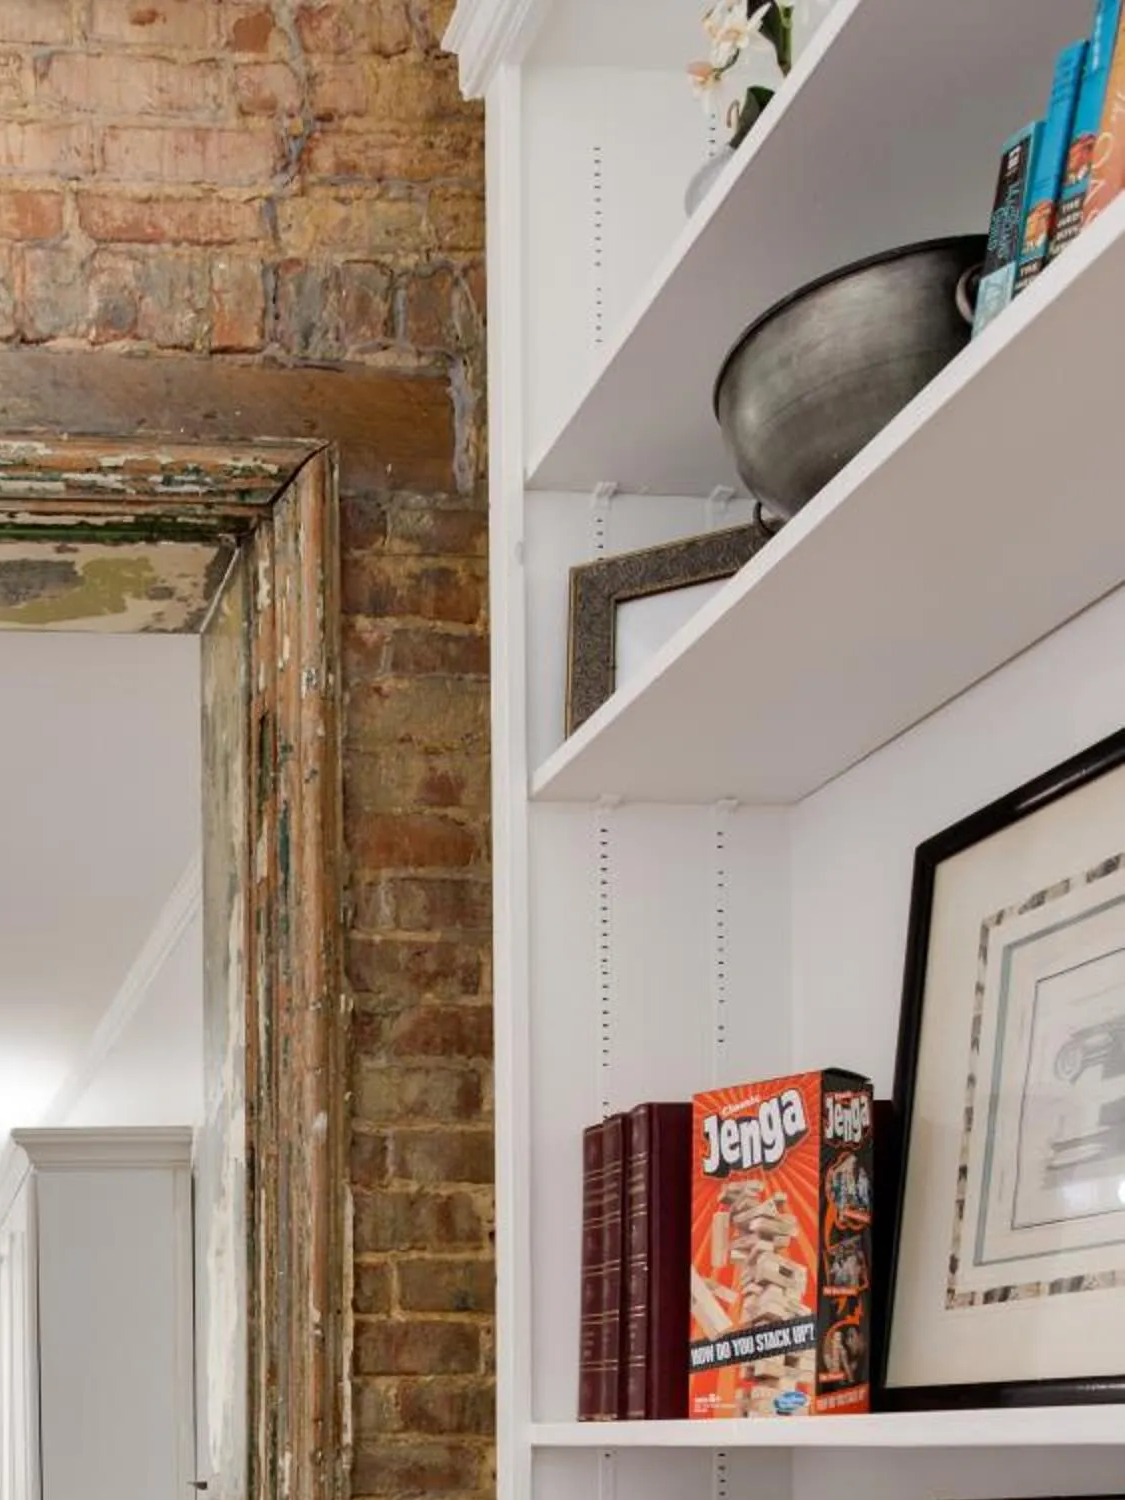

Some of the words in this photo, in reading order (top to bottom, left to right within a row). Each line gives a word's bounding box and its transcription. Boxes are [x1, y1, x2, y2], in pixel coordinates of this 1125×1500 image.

[703, 1089, 807, 1174] Jenga
[826, 1096, 871, 1143] Jenga
[690, 1343, 714, 1366] HOW
[716, 1341, 731, 1361] DO
[731, 1335, 755, 1357] YOU
[756, 1326, 792, 1352] STACK
